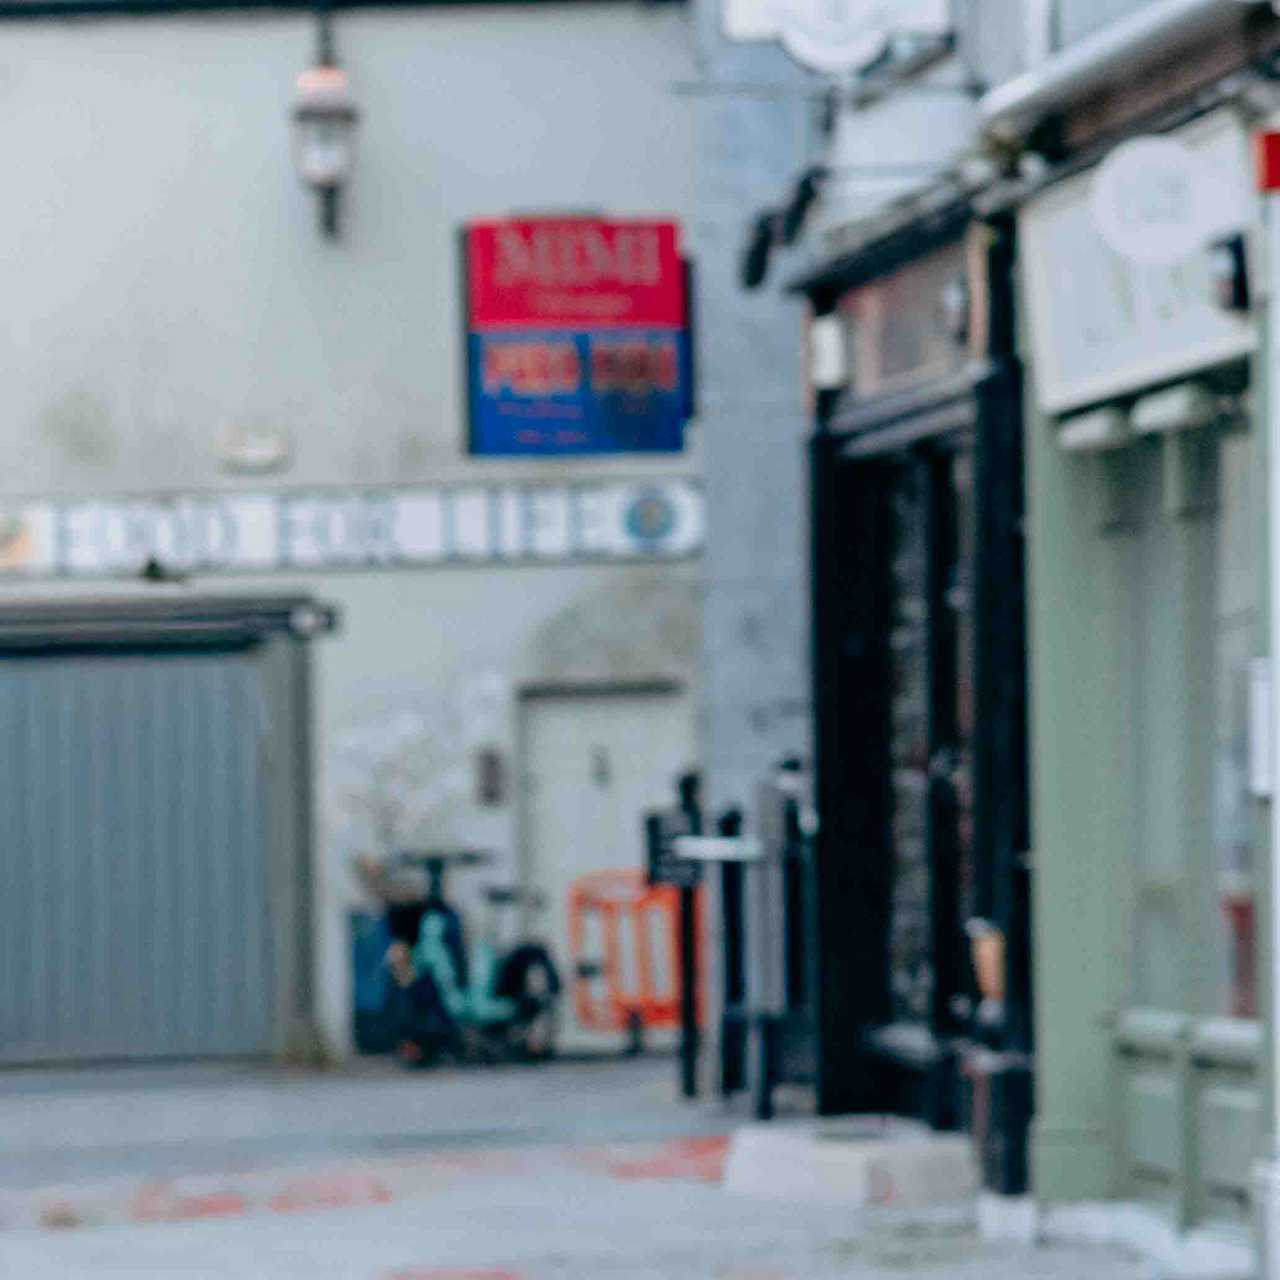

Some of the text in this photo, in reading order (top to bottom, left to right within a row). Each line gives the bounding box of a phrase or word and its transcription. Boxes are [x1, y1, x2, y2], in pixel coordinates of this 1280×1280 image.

[56, 485, 605, 572] FOOD FOR LIFE
